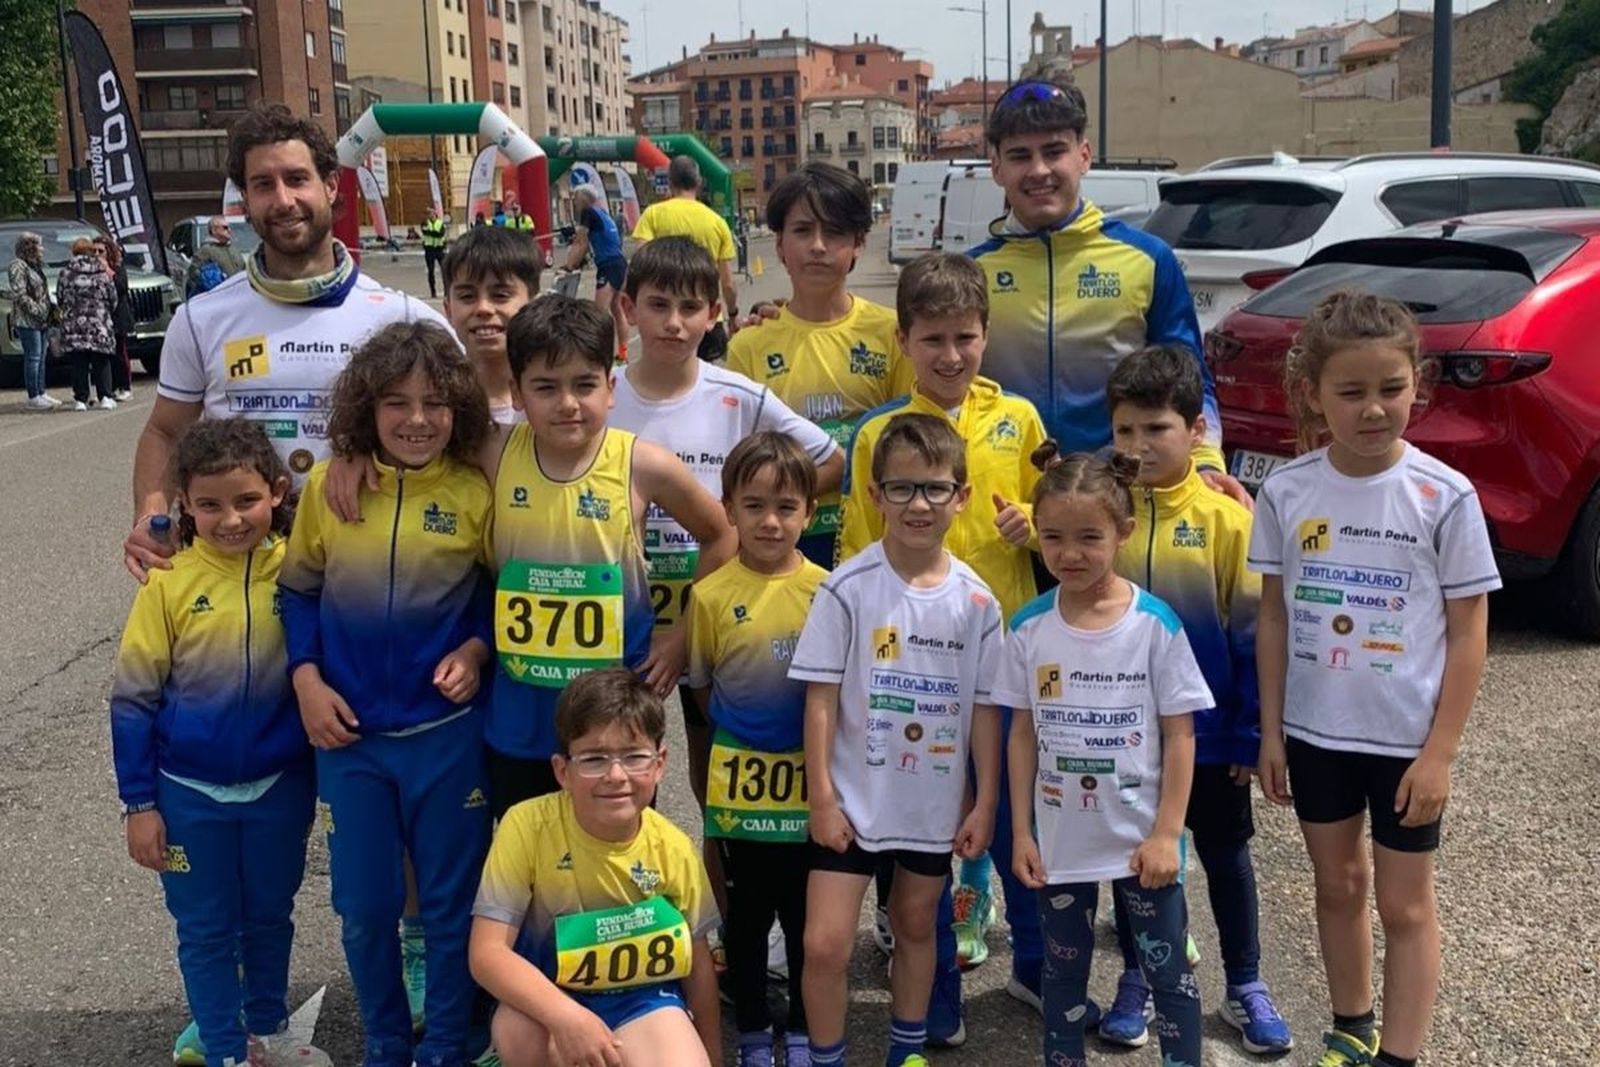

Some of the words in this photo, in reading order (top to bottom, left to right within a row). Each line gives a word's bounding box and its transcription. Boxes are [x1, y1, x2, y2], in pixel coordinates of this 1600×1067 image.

[1077, 287, 1121, 299] DUERO
[301, 424, 327, 434] VAL
[663, 533, 698, 543] VALD
[1357, 570, 1402, 588] DUERO
[506, 597, 604, 649] 370
[530, 665, 564, 680] CAJA
[1093, 711, 1137, 725] DUERO
[743, 818, 777, 831] CAJA
[567, 934, 676, 986] 408
